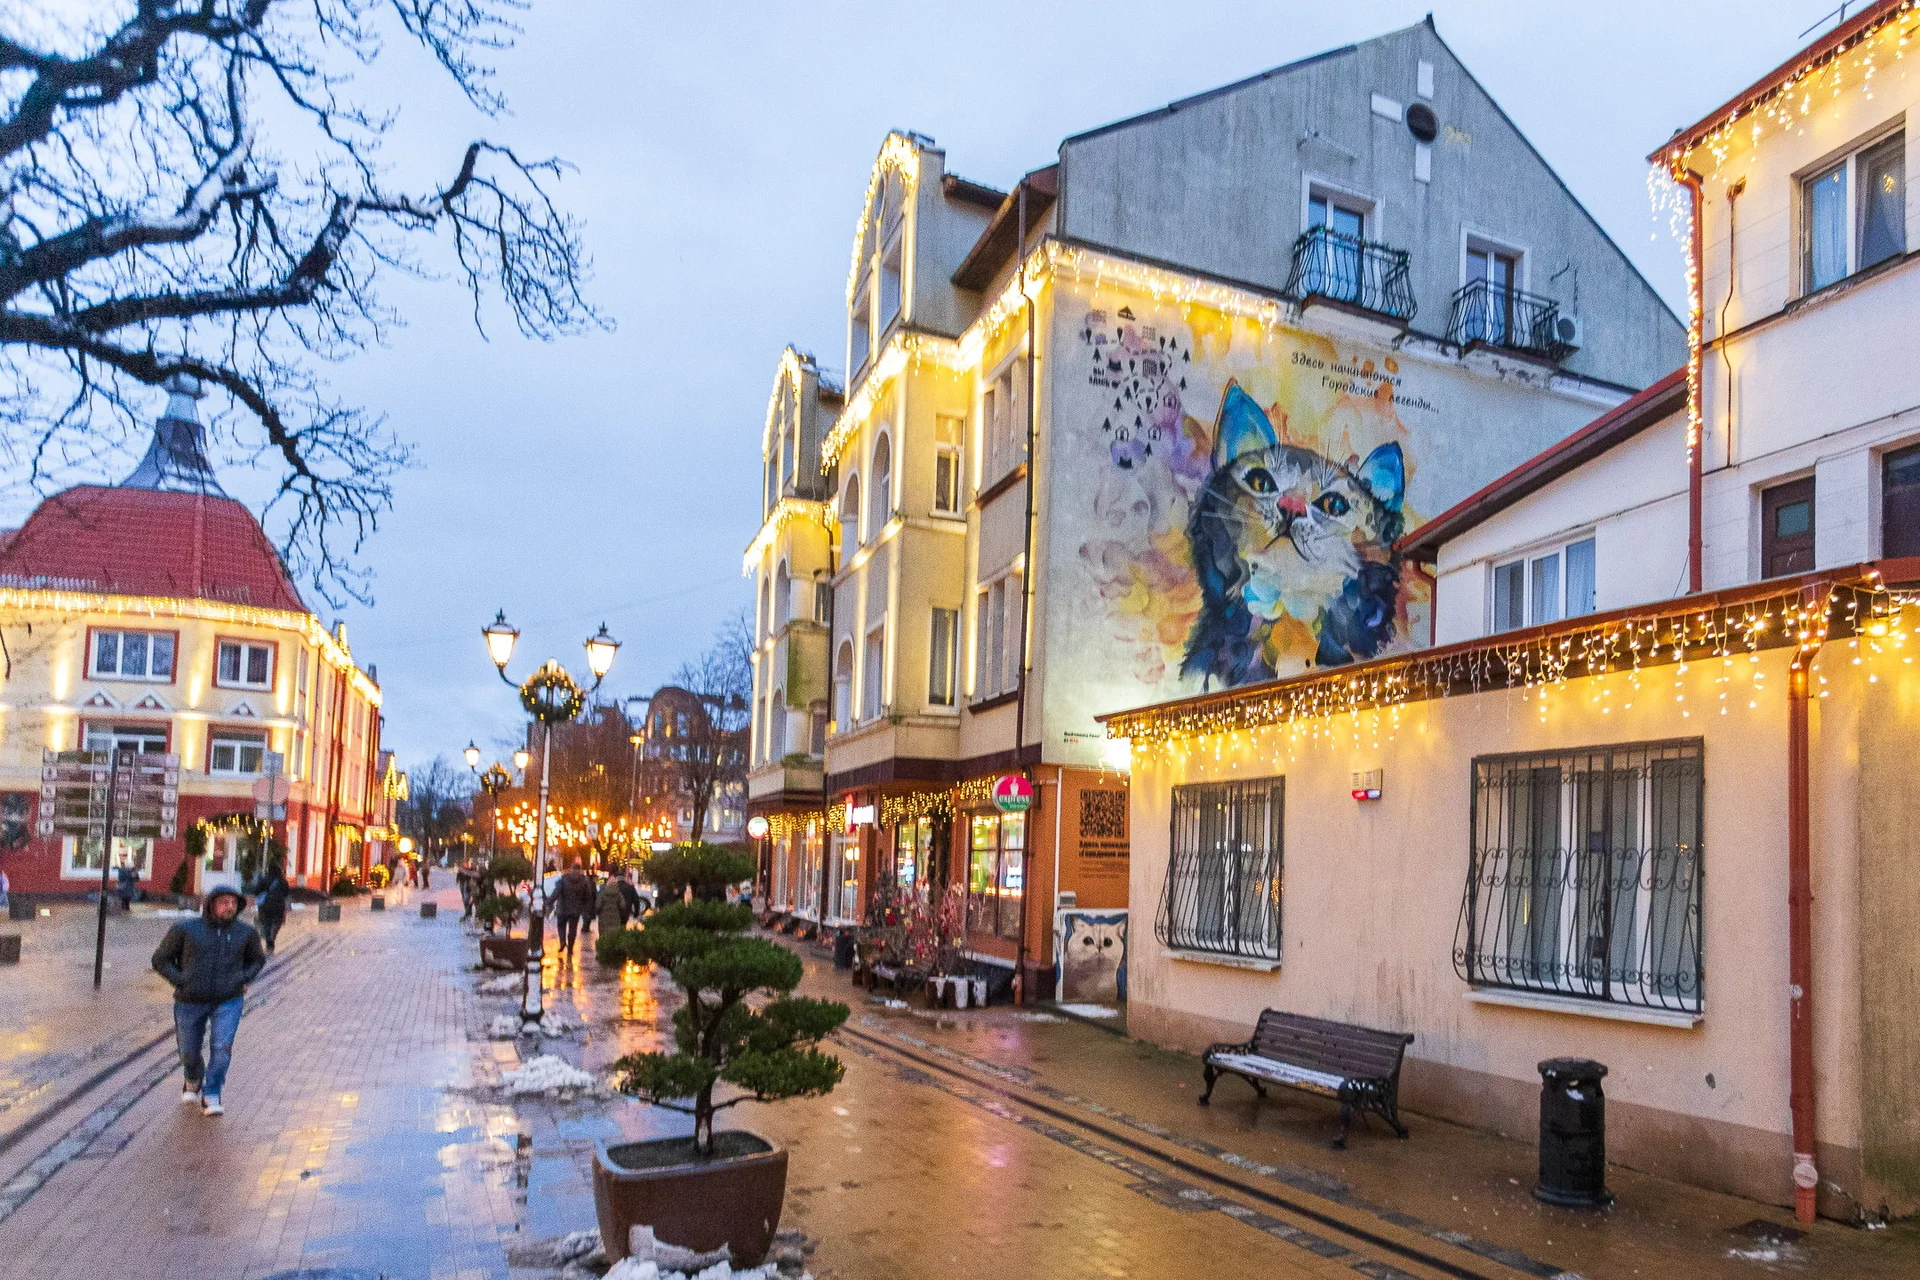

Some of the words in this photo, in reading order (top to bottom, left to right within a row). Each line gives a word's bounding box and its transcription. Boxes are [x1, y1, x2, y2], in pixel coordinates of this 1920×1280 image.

[1291, 351, 1325, 371] Здесь
[1330, 363, 1402, 387] начинаются
[1321, 375, 1379, 399] Городские
